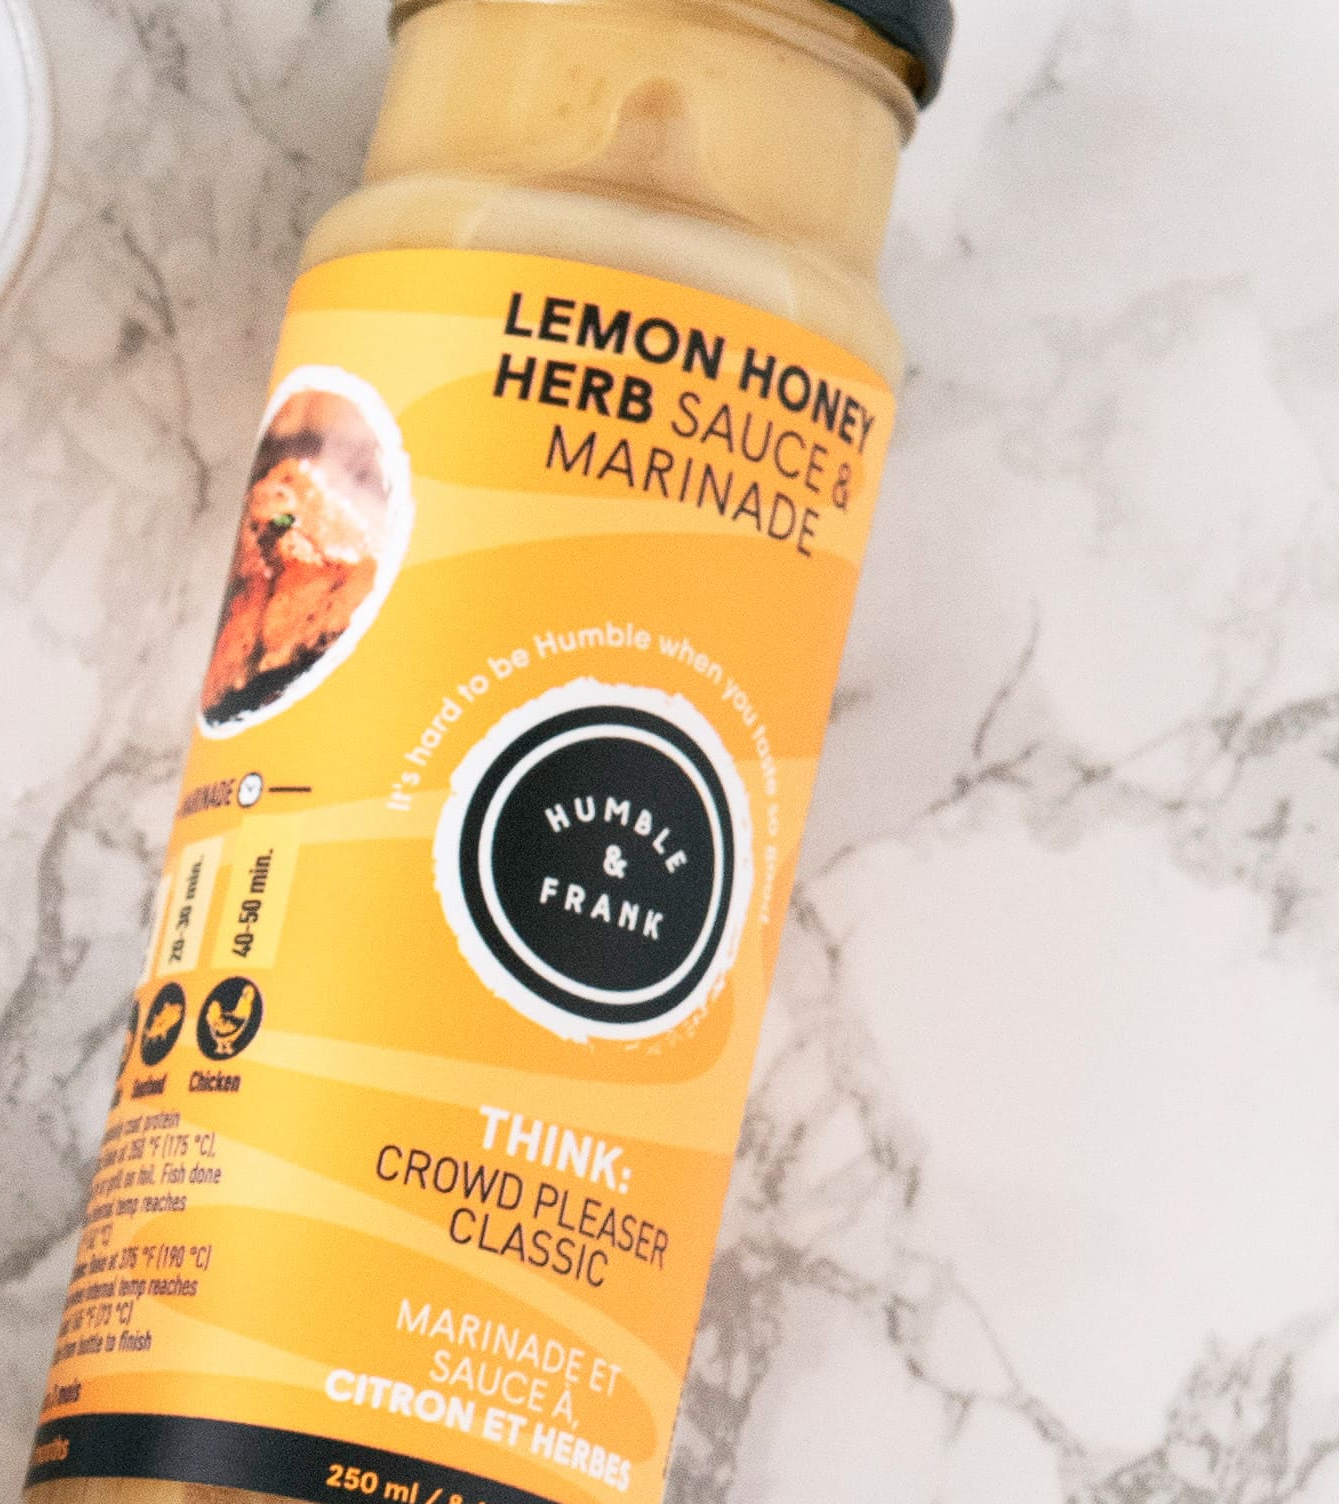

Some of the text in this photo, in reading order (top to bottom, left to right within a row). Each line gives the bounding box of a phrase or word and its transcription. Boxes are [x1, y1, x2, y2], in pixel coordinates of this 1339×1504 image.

[504, 292, 874, 455] LEMON HONEY
[493, 353, 853, 511] HERB SAUCE &
[546, 424, 821, 557] MARINADE
[386, 767, 421, 812] It's
[410, 698, 463, 767] hard
[457, 674, 489, 703] to
[487, 647, 529, 679] be
[534, 622, 652, 659] Humble
[658, 633, 723, 685] when
[722, 677, 758, 727] you
[544, 795, 688, 875] HUMBLE
[602, 844, 627, 878] &
[232, 848, 274, 959] 40-50 min.
[539, 877, 664, 940] FRANK
[189, 1071, 241, 1093] Chicken
[160, 1162, 186, 1184] Fish
[189, 1162, 222, 1184] done
[480, 1105, 631, 1194] THINK:
[142, 1192, 187, 1212] reaches
[376, 1145, 669, 1270] CROWD PLEASER
[147, 1274, 198, 1297] reaches
[449, 1208, 609, 1287] CLASSIC
[118, 1329, 152, 1351] finish
[396, 1298, 622, 1396] MARINADE ET
[429, 1350, 548, 1412] SAUCE
[325, 1368, 631, 1493] CITRON ET HERBES
[325, 1464, 378, 1494] 250
[384, 1480, 419, 1504] ml
